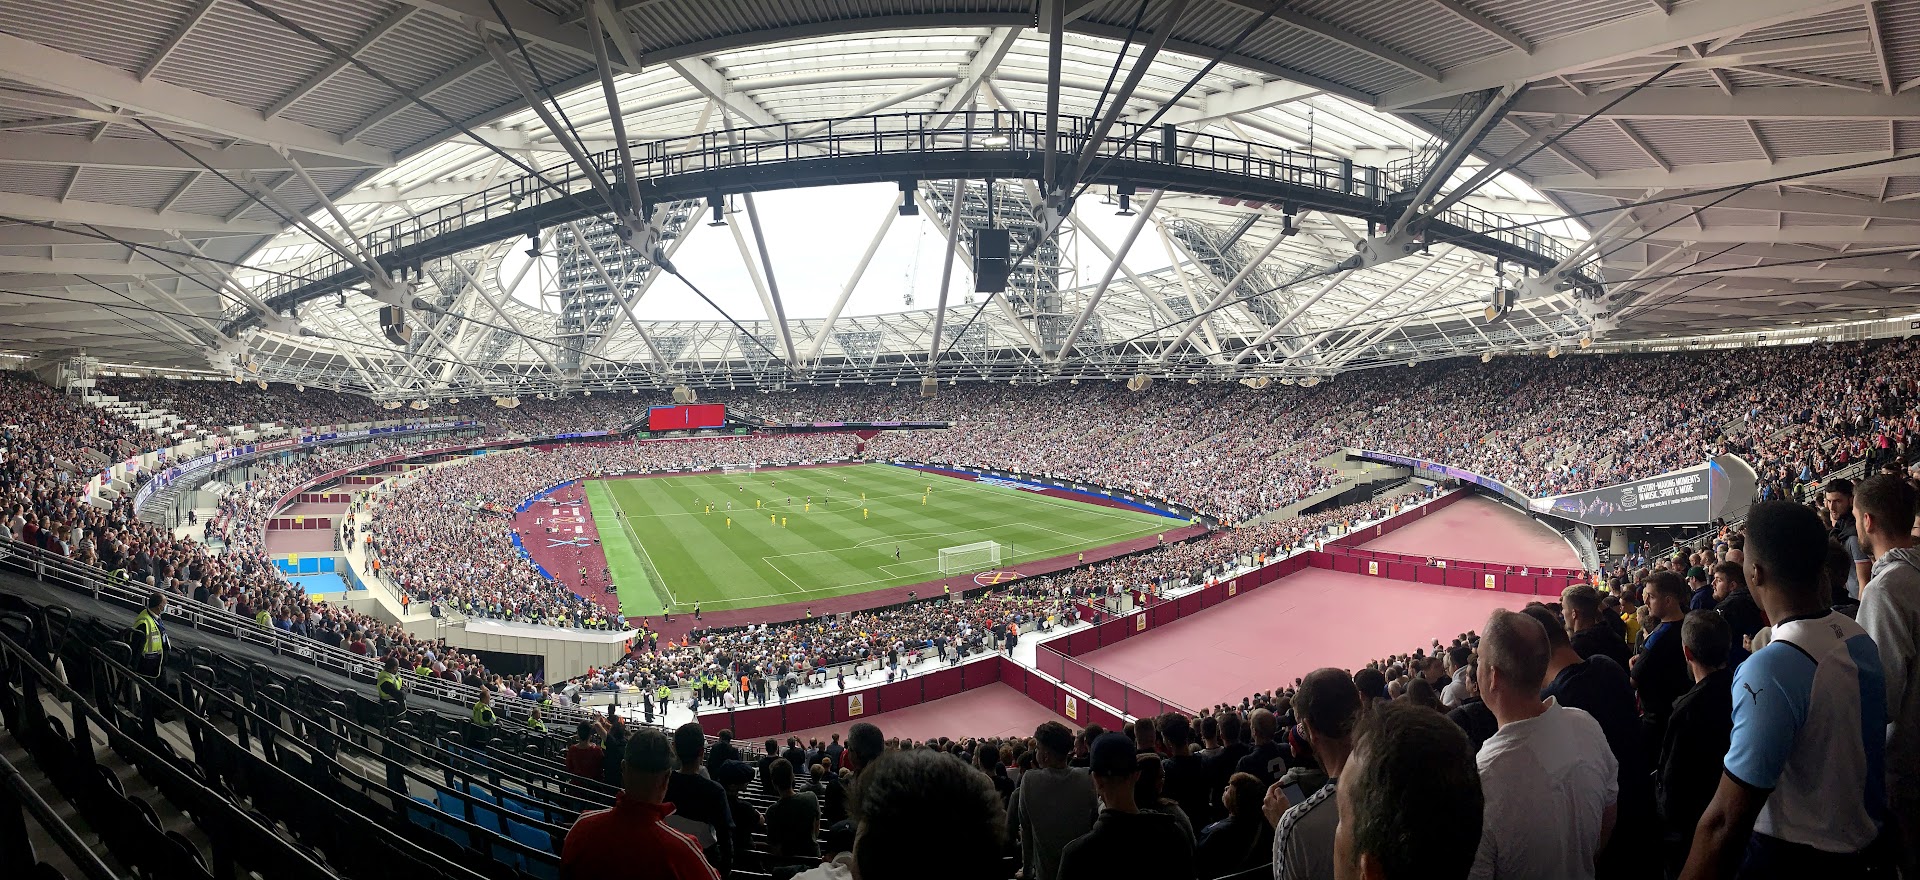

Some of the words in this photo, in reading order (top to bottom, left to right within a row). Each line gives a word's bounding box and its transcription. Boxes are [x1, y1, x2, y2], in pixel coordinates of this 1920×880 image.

[1676, 474, 1701, 486] MOMENTS
[1660, 488, 1675, 497] SPORT
[1679, 484, 1694, 494] MORE
